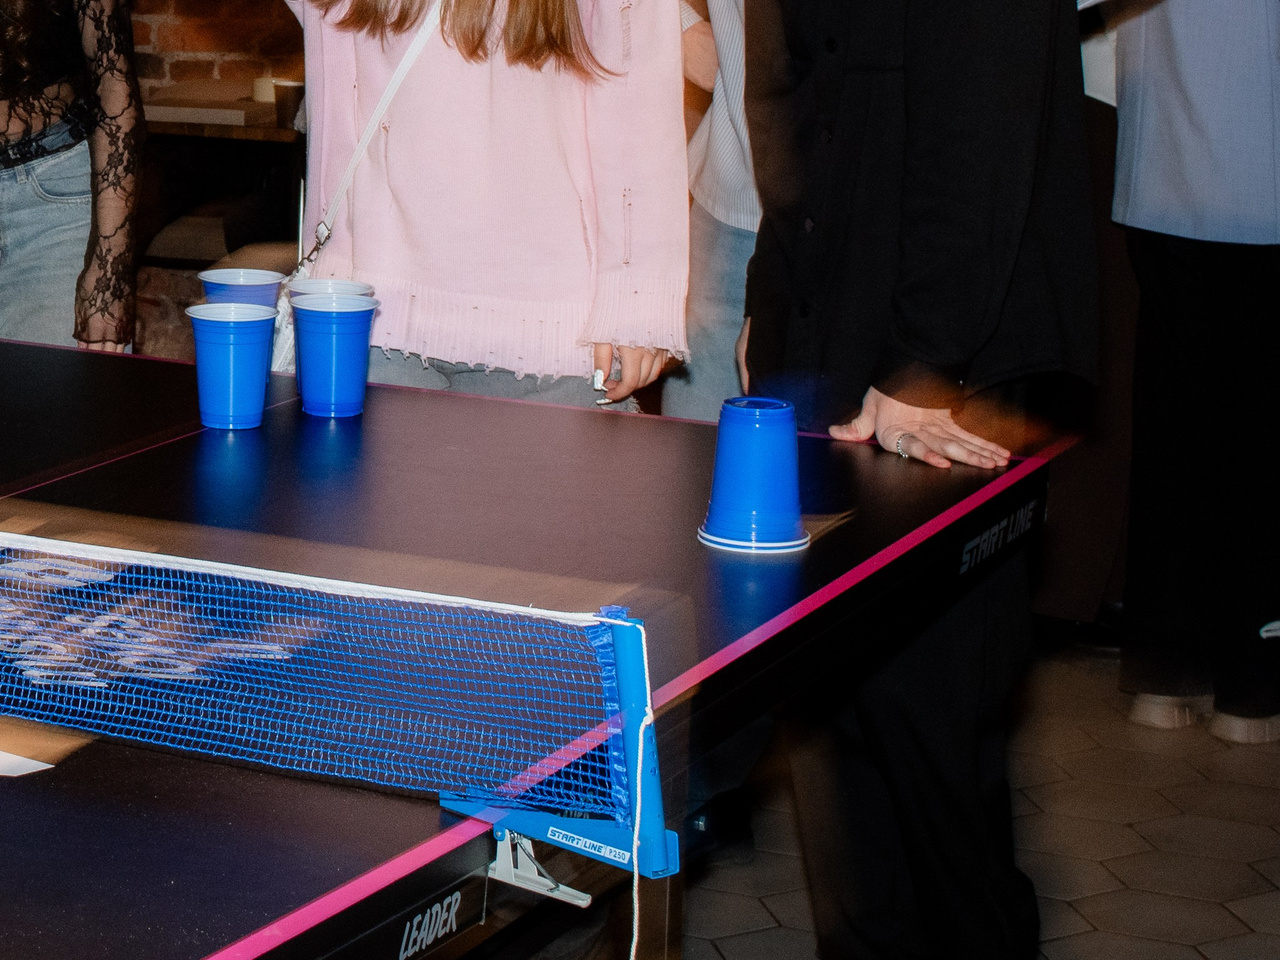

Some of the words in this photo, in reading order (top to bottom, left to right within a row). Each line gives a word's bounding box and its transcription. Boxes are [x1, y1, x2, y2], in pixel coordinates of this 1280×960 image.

[959, 517, 1009, 575] START
[1006, 499, 1038, 544] LINE
[64, 613, 211, 681] loves
[549, 828, 582, 846] START
[583, 839, 604, 854] LINE
[399, 890, 461, 960] LEADER
